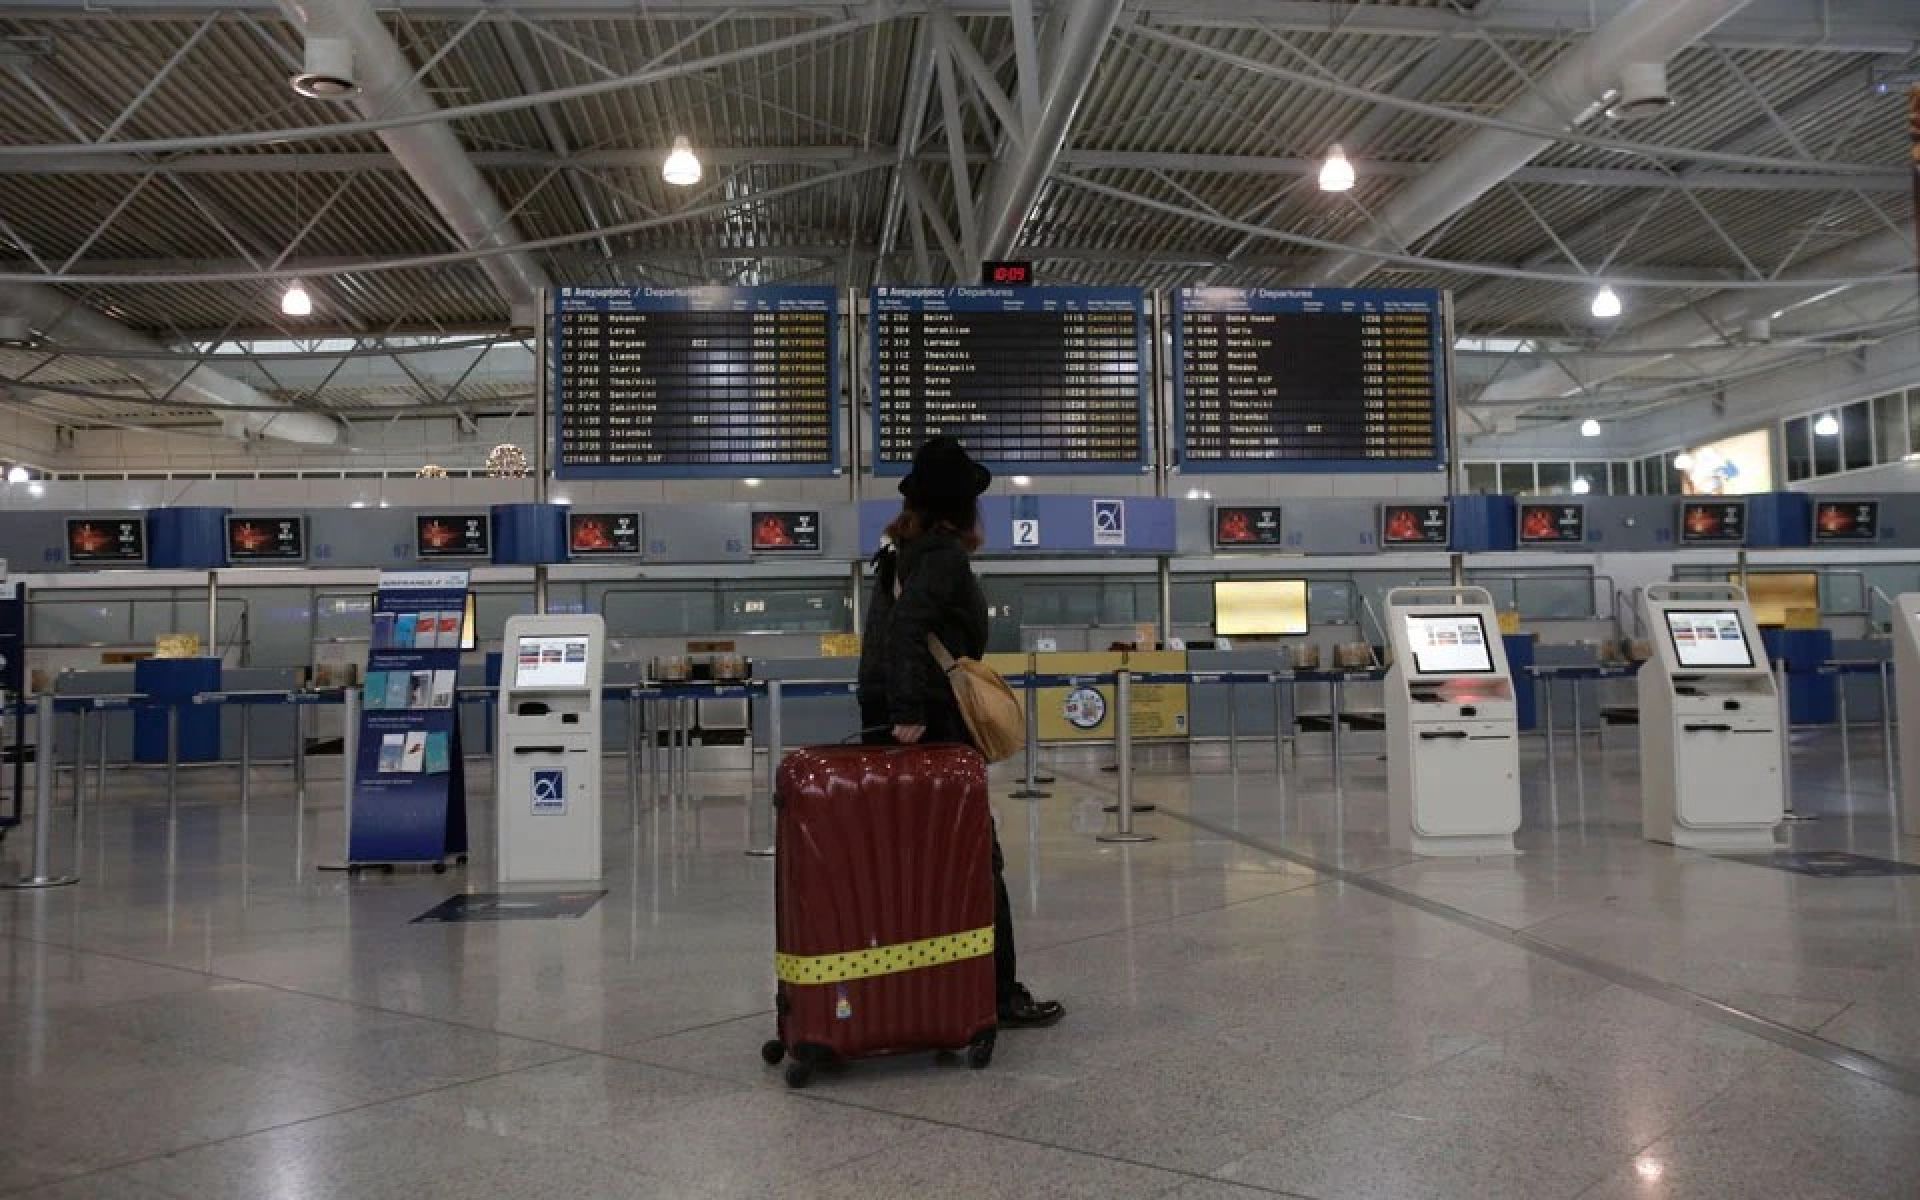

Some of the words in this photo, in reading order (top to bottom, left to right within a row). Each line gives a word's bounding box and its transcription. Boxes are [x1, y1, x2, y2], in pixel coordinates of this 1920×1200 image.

[957, 287, 1014, 298] Departures
[1259, 288, 1313, 299] Departures
[1019, 521, 1033, 543] 2
